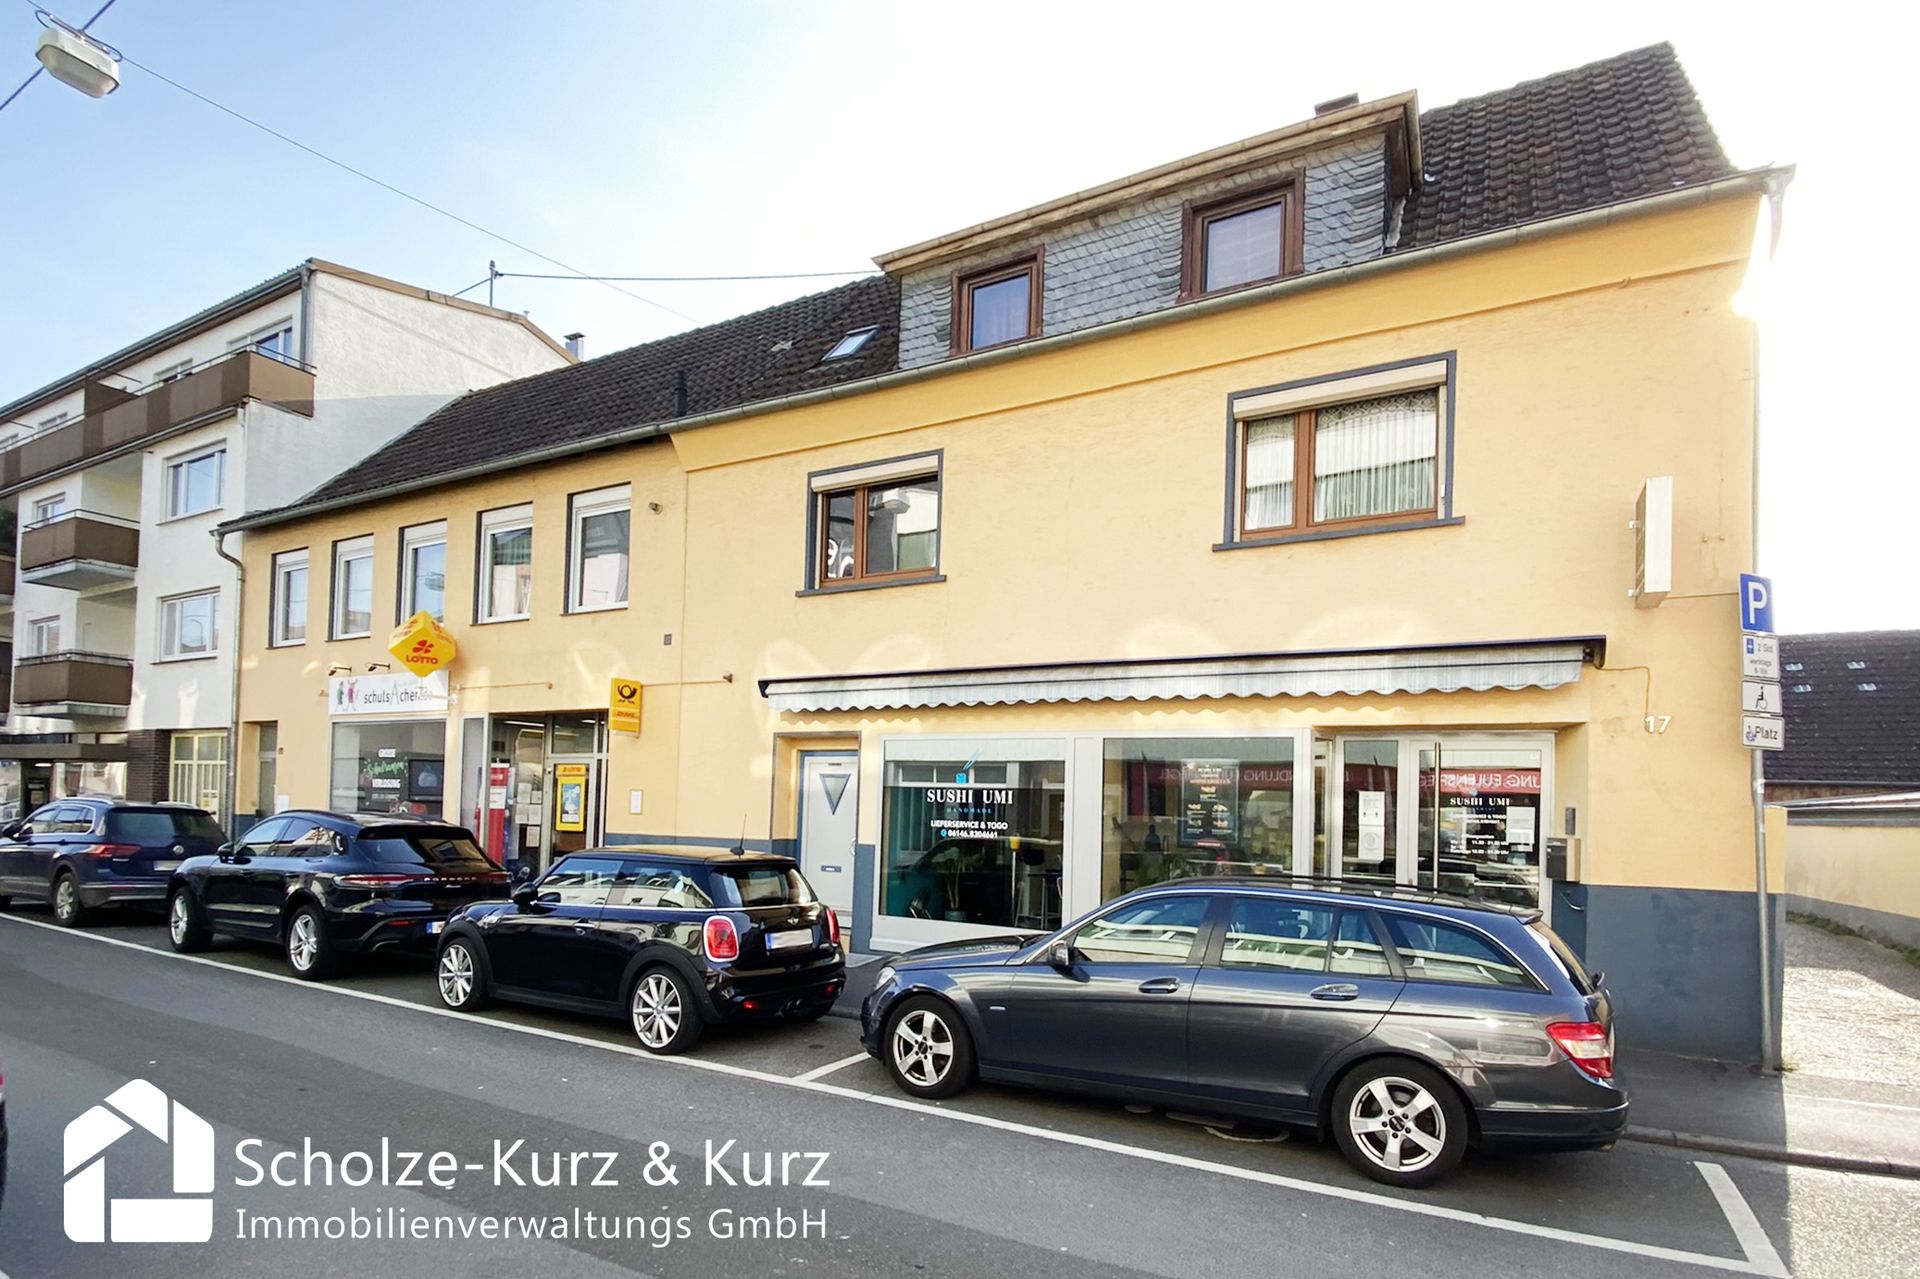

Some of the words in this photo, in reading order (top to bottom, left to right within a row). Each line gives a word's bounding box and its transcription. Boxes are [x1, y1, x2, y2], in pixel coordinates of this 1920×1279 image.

[1748, 581, 1768, 624] P
[406, 655, 439, 665] LOTTO
[1645, 715, 1671, 733] 17
[1755, 726, 1778, 740] Platz
[927, 789, 973, 802] SUSHI
[983, 790, 1013, 803] UMI
[1449, 798, 1483, 806] SUSHI
[1489, 798, 1510, 806] UMI
[931, 820, 979, 829] LIEFERSERVICE
